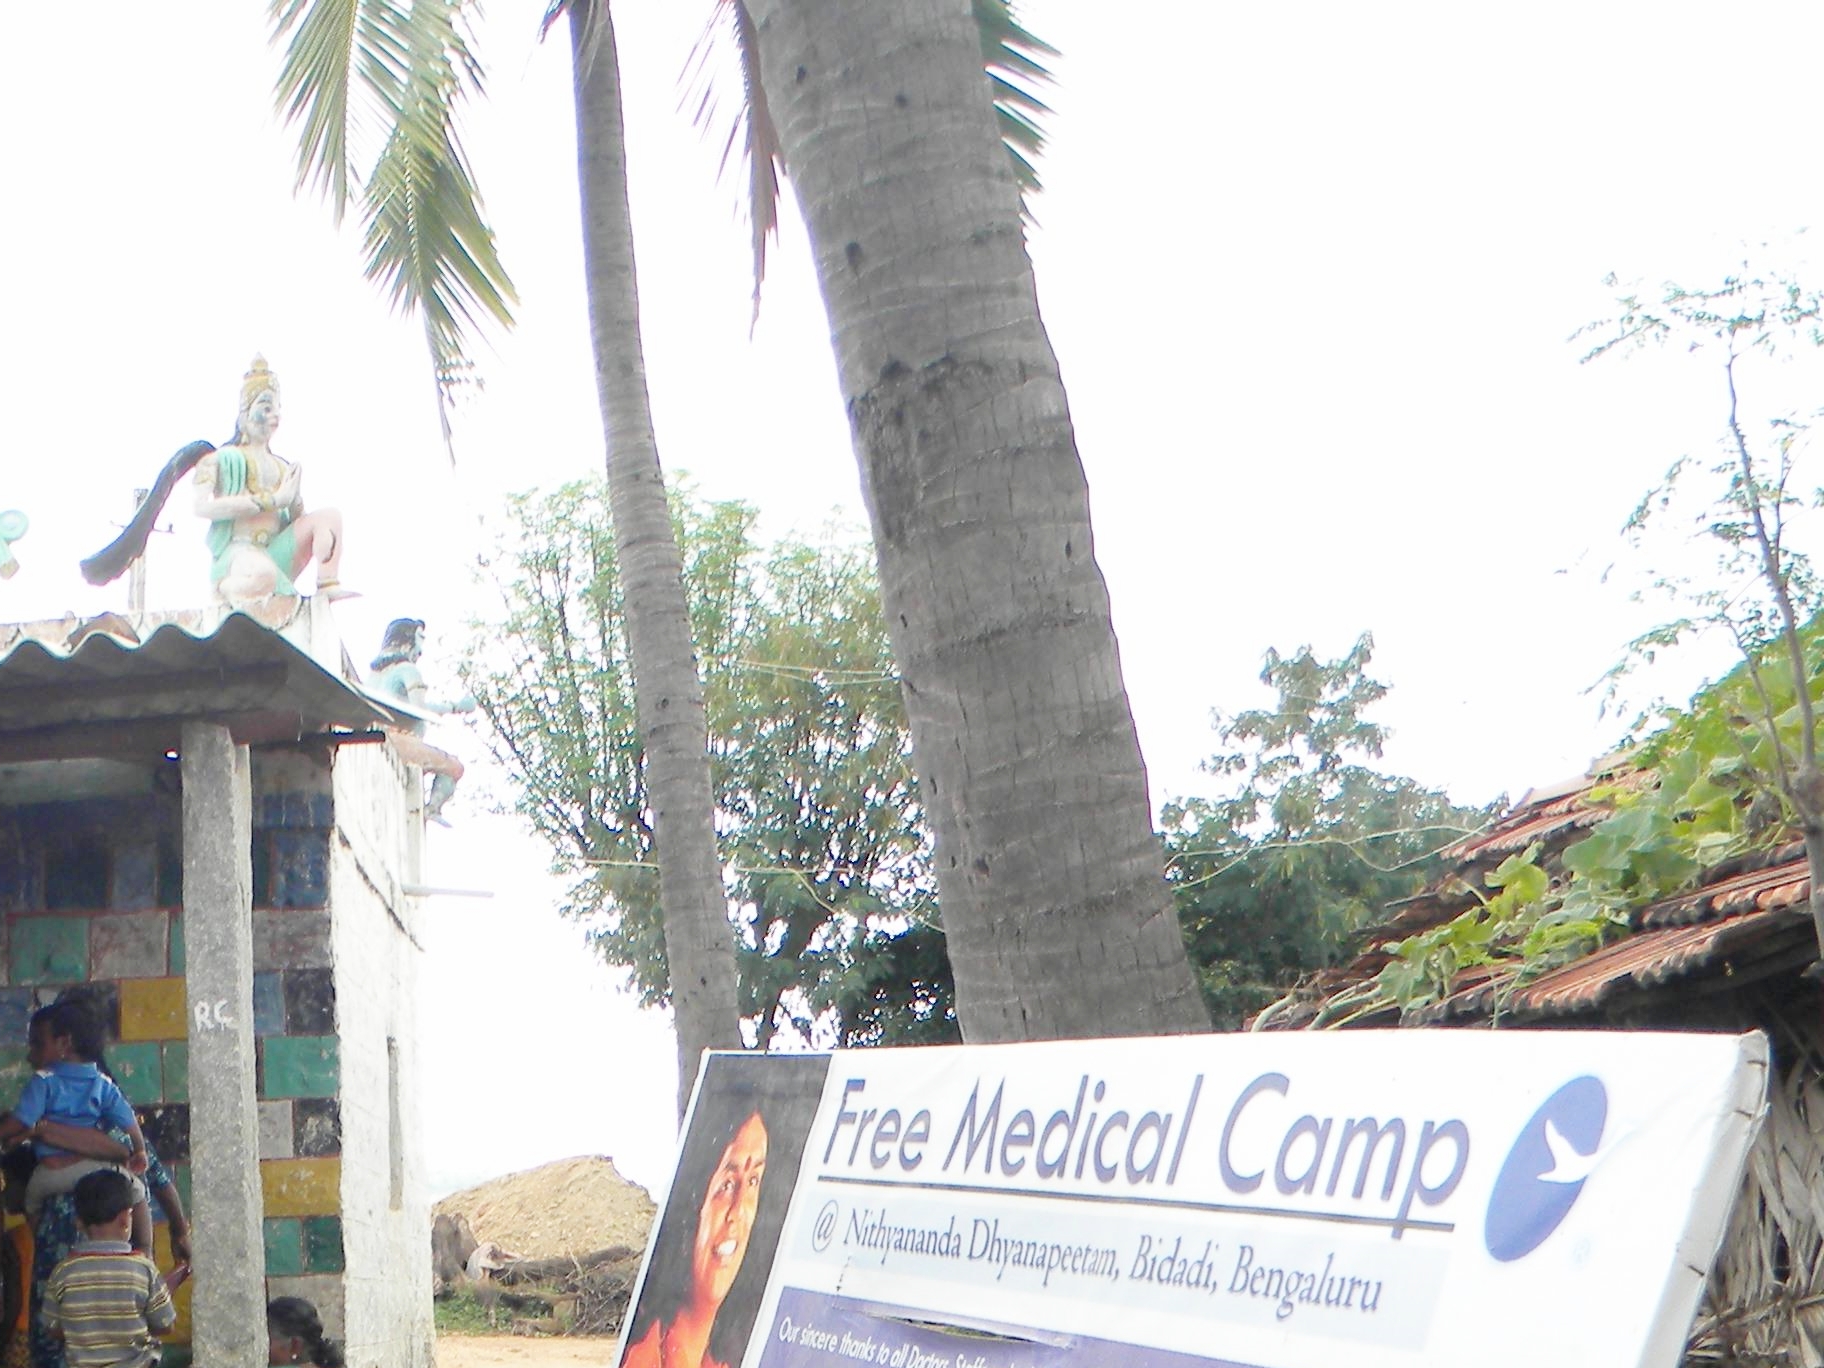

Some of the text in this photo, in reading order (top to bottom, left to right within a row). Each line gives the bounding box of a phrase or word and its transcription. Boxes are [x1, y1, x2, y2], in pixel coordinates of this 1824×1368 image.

[822, 1071, 1470, 1240] Free Medical Camp
[812, 1199, 1383, 1321] @ Nithyananda Dhyanapeetam, Bidadi, Bengaluru
[778, 1316, 802, 1344] Our
[801, 1322, 838, 1352] sincere
[839, 1330, 875, 1362] thanks
[876, 1343, 890, 1366] to
